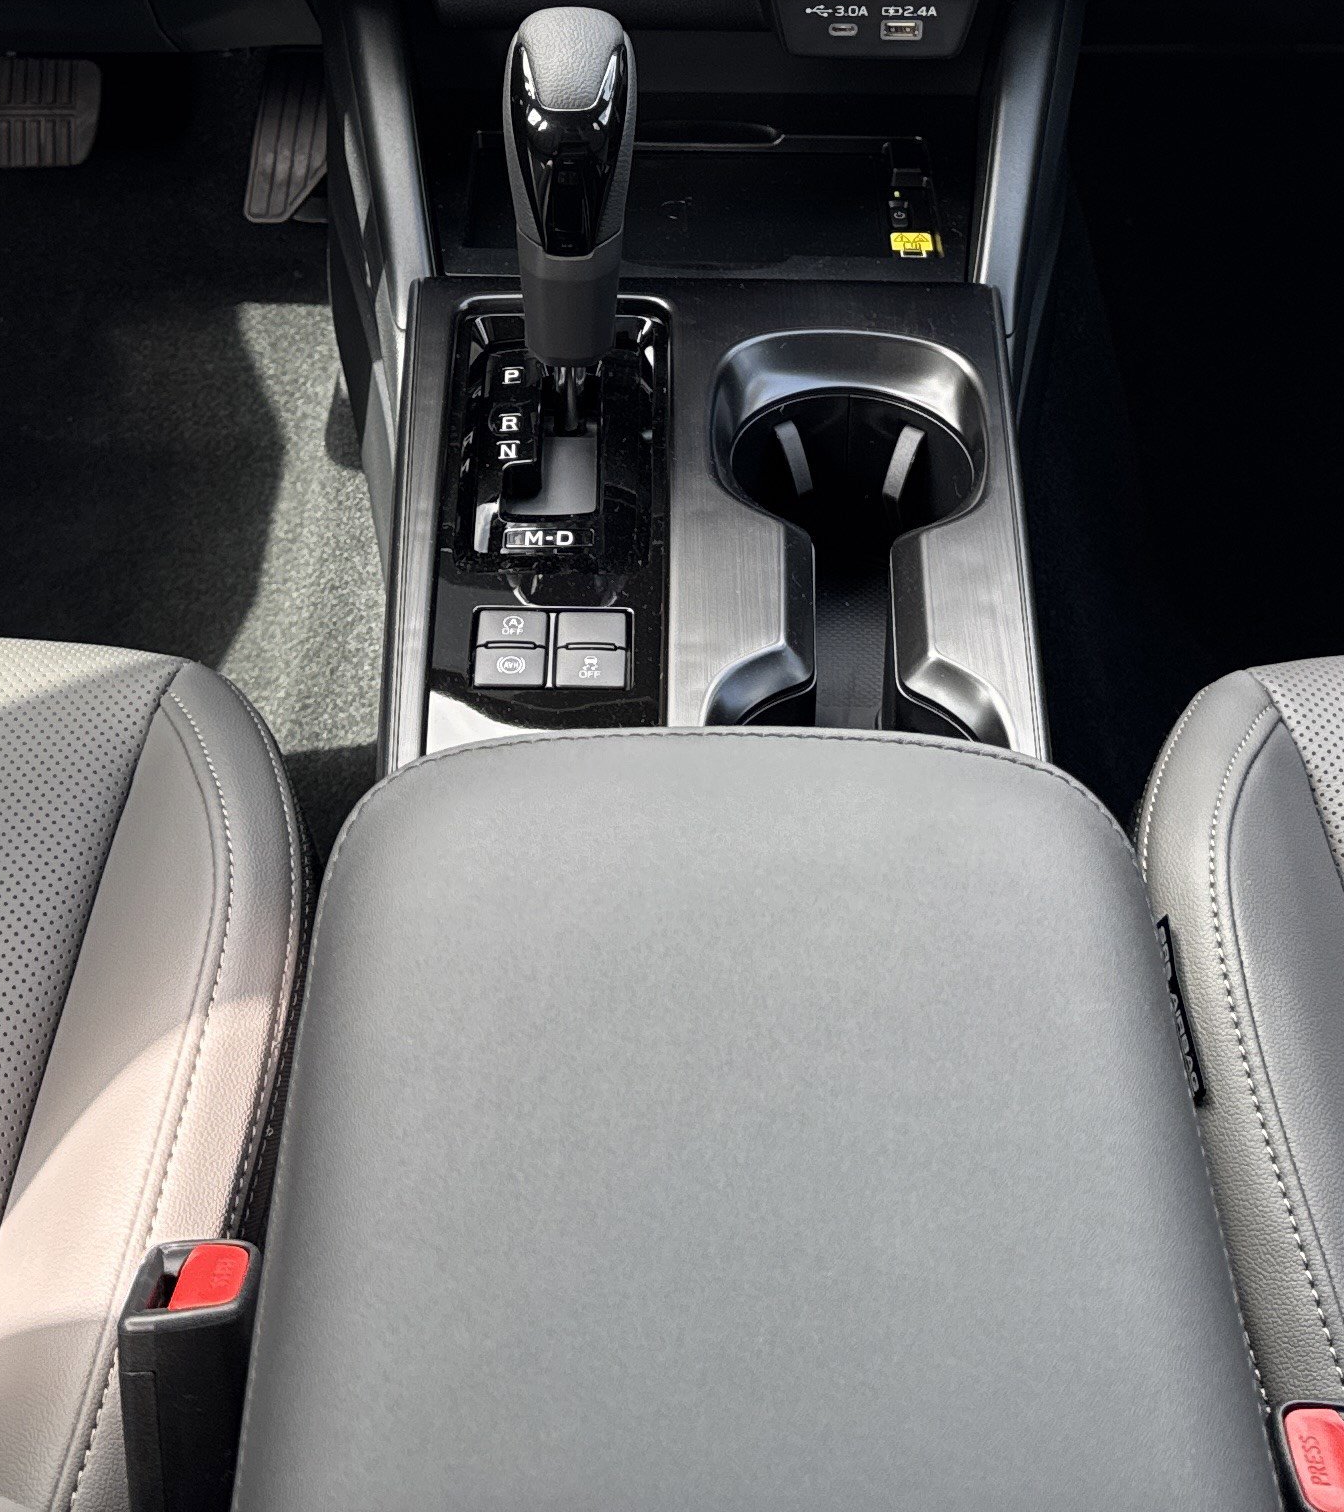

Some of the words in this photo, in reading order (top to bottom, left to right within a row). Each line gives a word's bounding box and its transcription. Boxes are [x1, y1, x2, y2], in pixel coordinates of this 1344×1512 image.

[834, 5, 869, 17] 3.0A
[903, 6, 938, 17] 2.4A
[504, 368, 520, 384] P
[501, 415, 518, 430] R
[500, 443, 517, 459] N
[523, 530, 574, 547] M-D
[578, 670, 602, 678] OFF
[1298, 1435, 1332, 1487] PRESS
